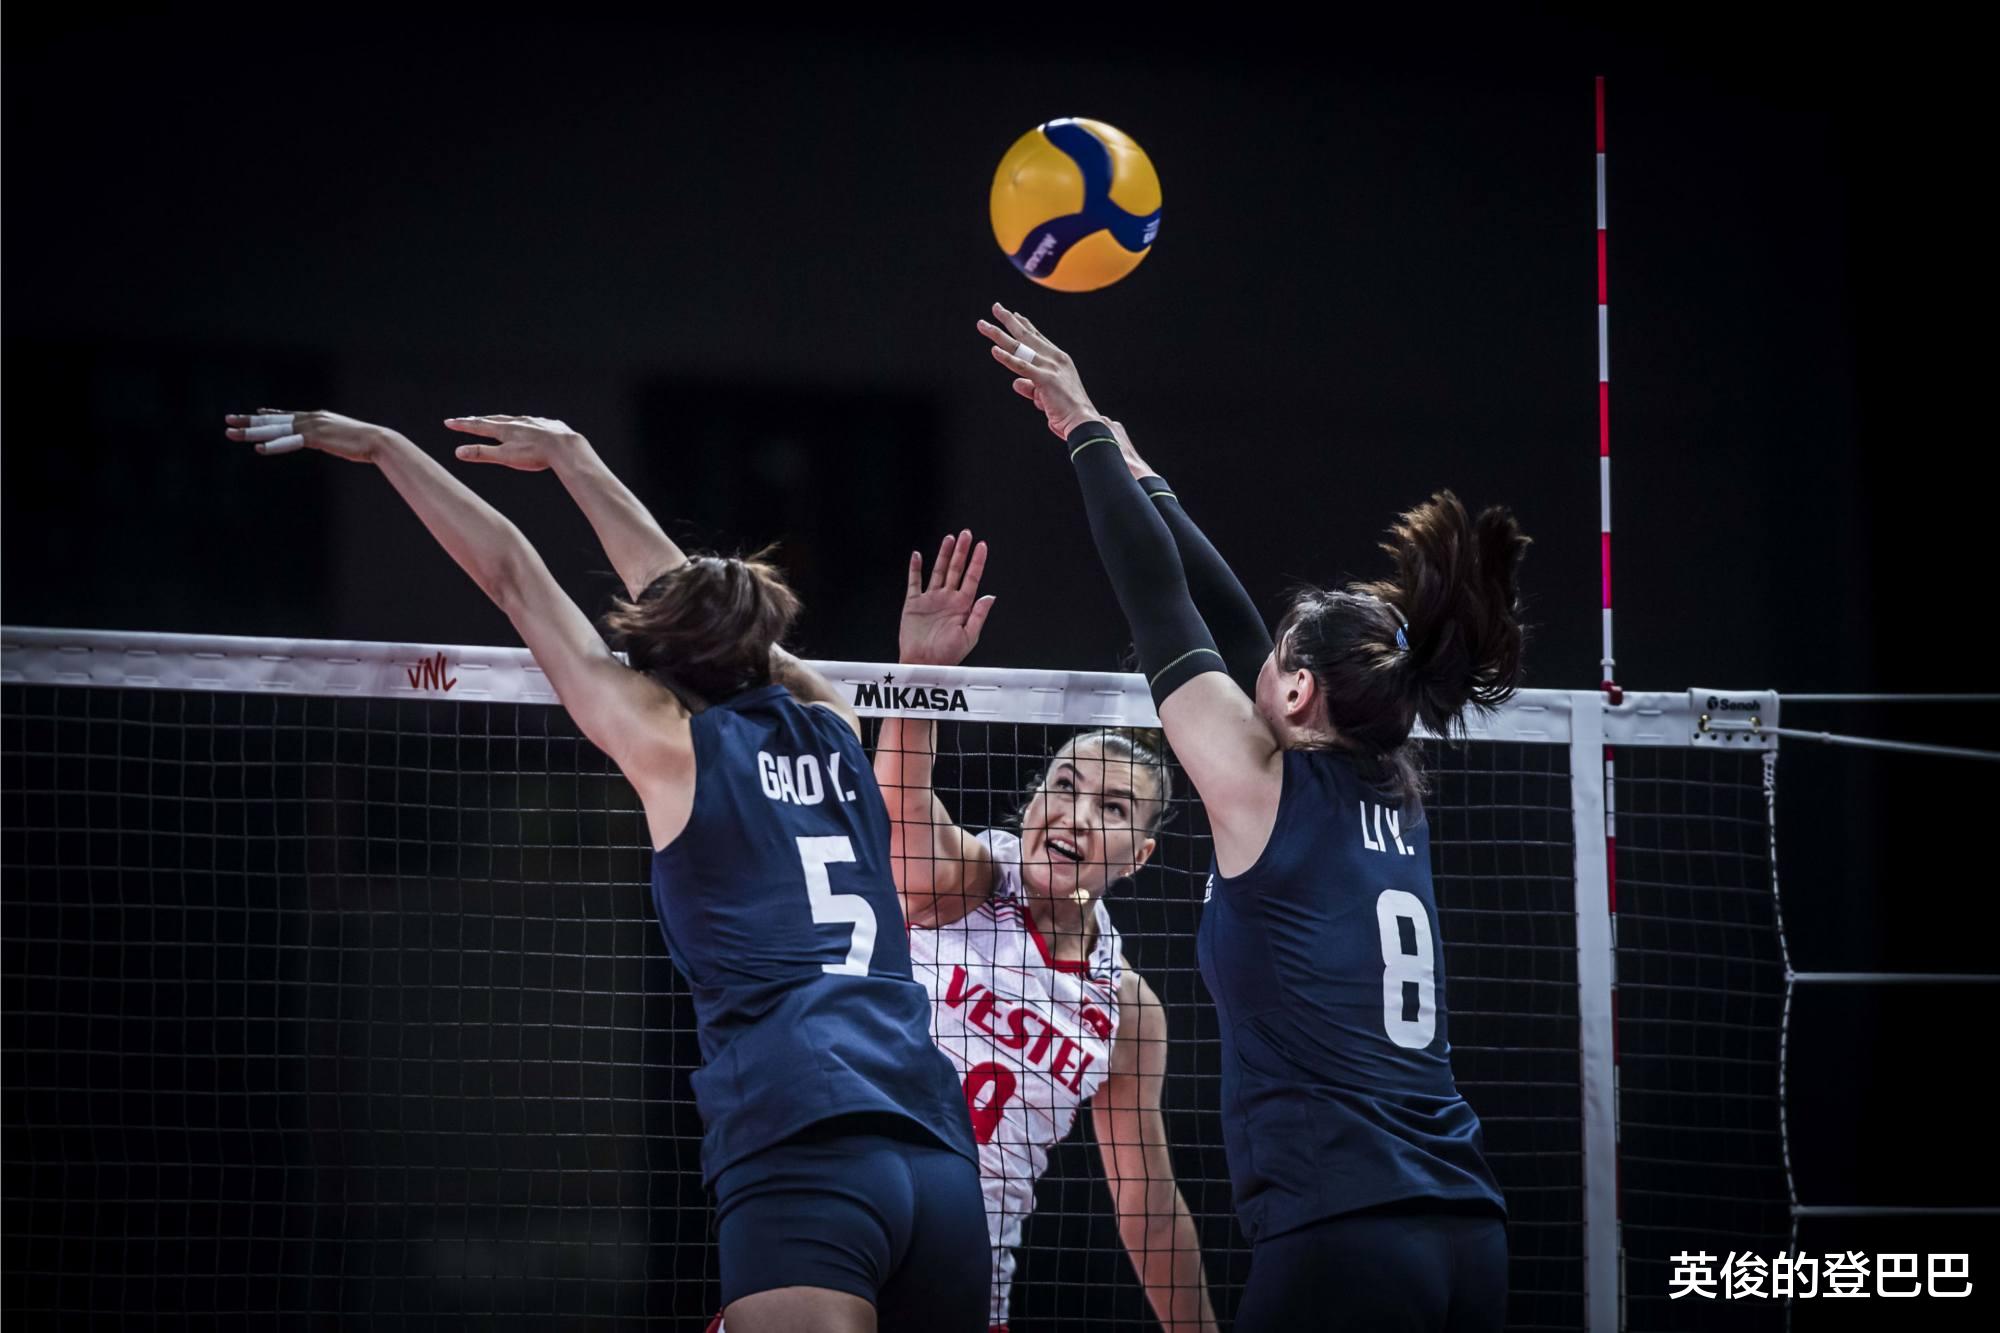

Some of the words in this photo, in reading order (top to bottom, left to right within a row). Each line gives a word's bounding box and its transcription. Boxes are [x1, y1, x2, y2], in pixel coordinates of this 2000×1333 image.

[408, 651, 457, 692] VNL
[854, 673, 969, 712] MIKASA
[1720, 698, 1760, 711] Senoh
[757, 750, 824, 805] GAO
[827, 751, 857, 802] Y.
[1360, 800, 1387, 852] LI
[1386, 807, 1415, 855] Y.
[795, 835, 877, 977] 5
[1376, 888, 1436, 1050] 8
[945, 963, 1095, 1096] VESTEL
